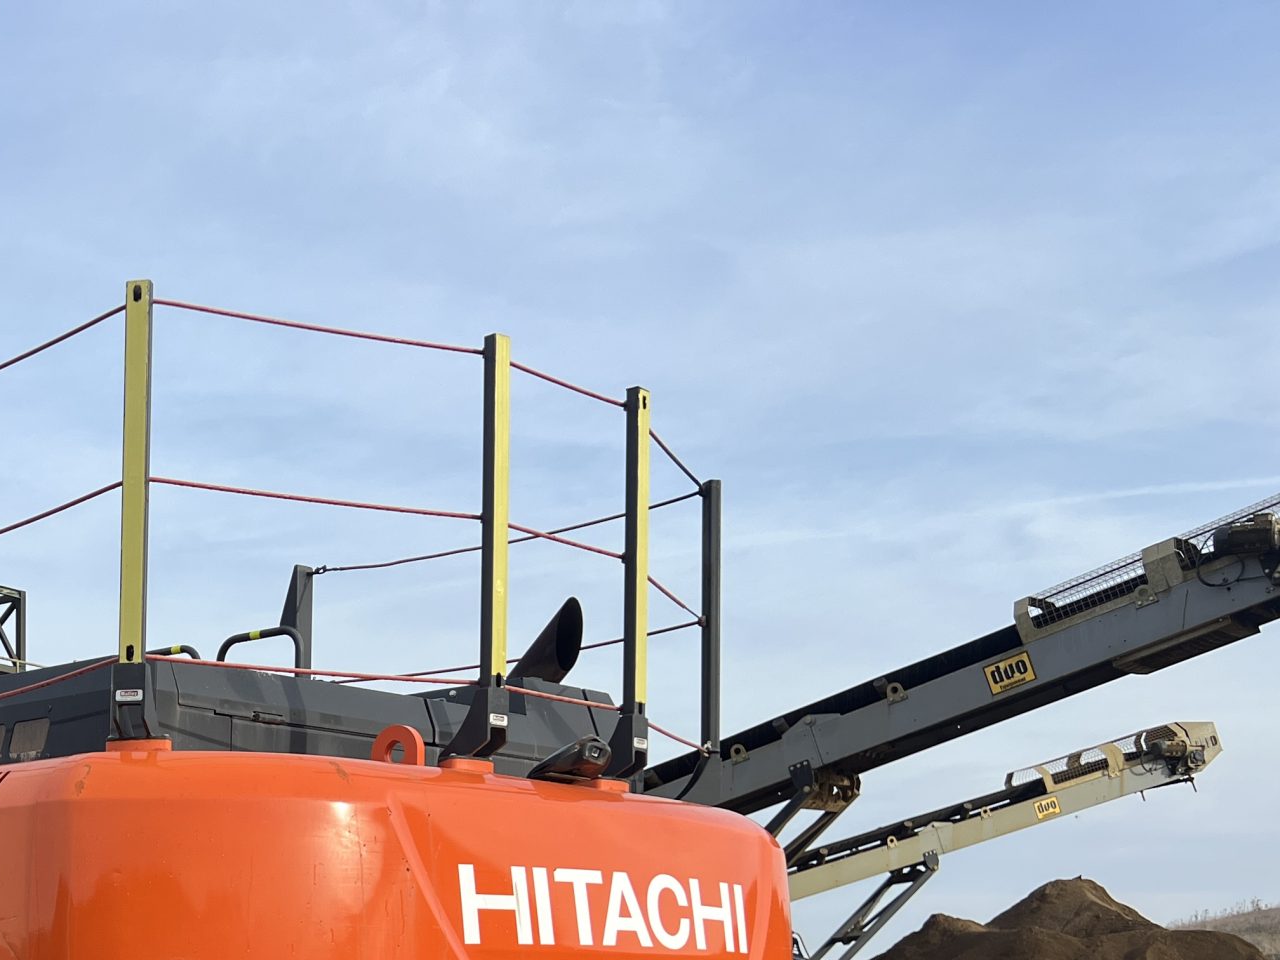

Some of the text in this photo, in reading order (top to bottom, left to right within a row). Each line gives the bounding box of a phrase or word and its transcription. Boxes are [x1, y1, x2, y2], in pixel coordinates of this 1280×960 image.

[990, 659, 1028, 684] duo
[1037, 800, 1057, 814] duo
[458, 864, 748, 954] HITACHI
